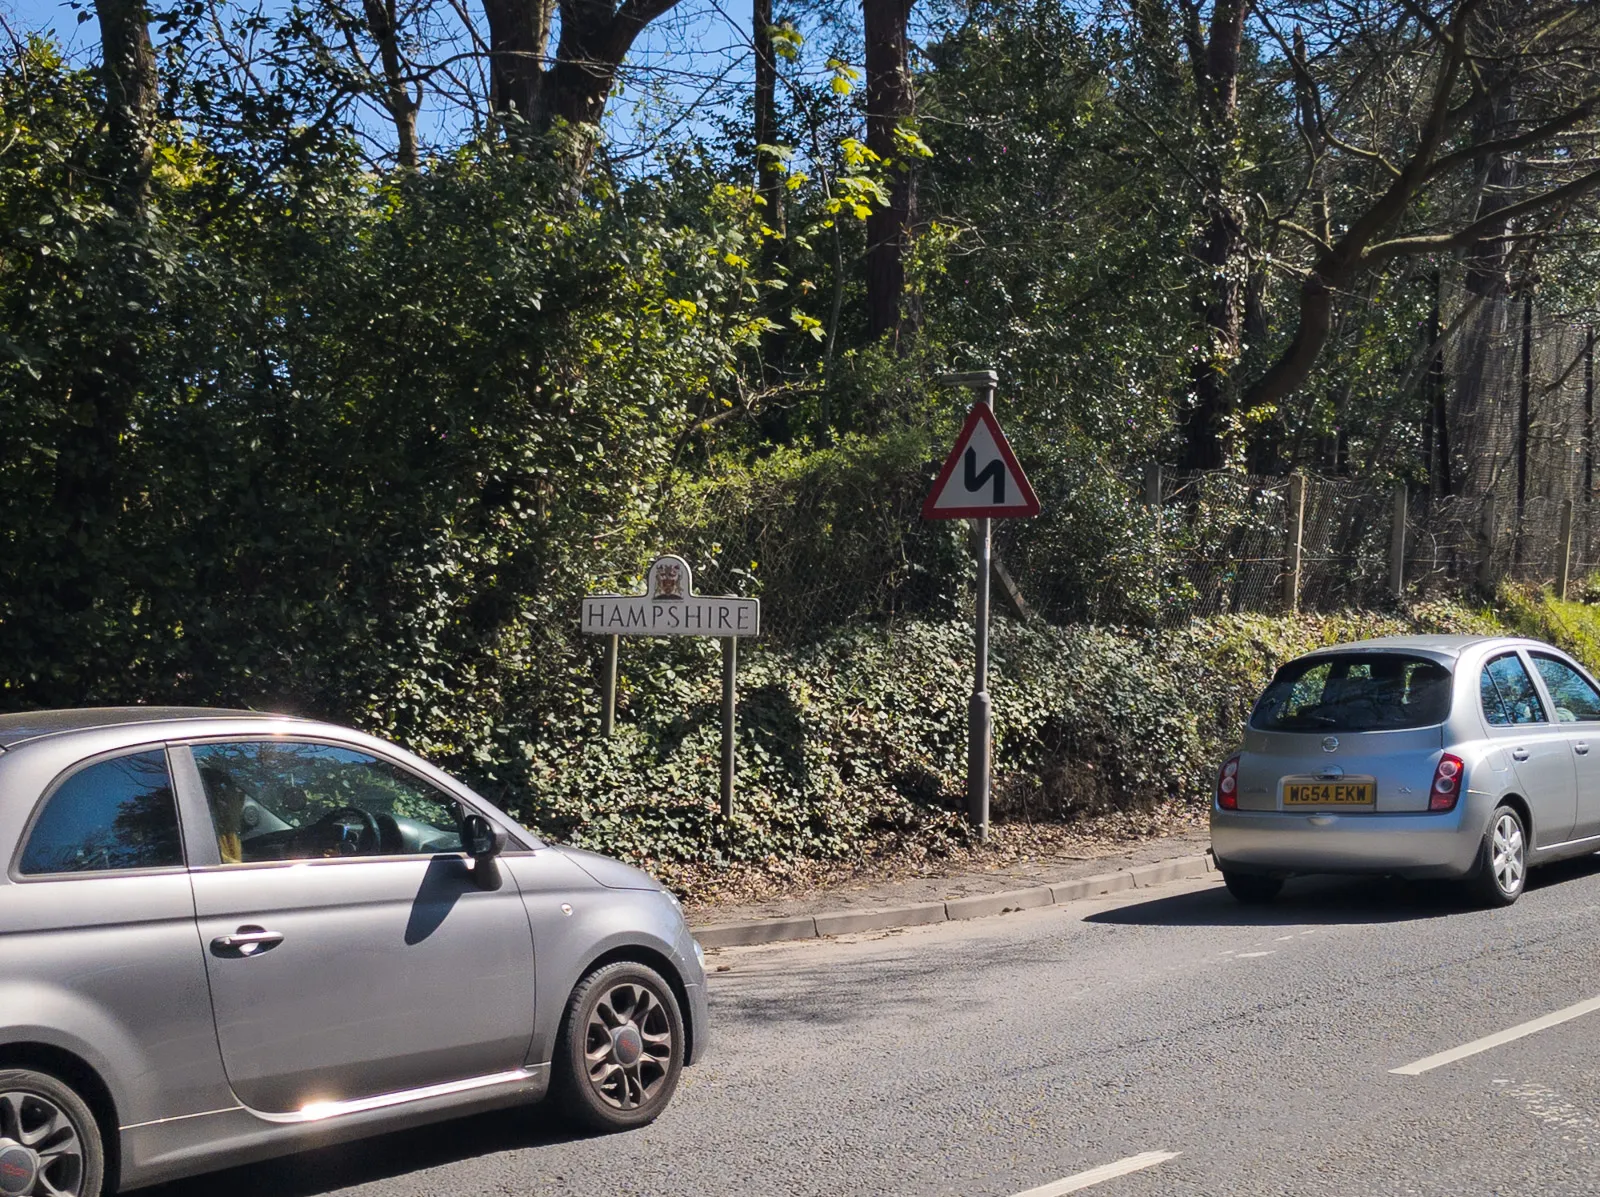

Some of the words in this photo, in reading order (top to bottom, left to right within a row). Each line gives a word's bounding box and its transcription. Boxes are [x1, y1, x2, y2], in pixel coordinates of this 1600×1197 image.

[588, 604, 749, 630] HAMPSHIRE
[1290, 786, 1330, 802] WG54
[1335, 786, 1366, 802] EKW
